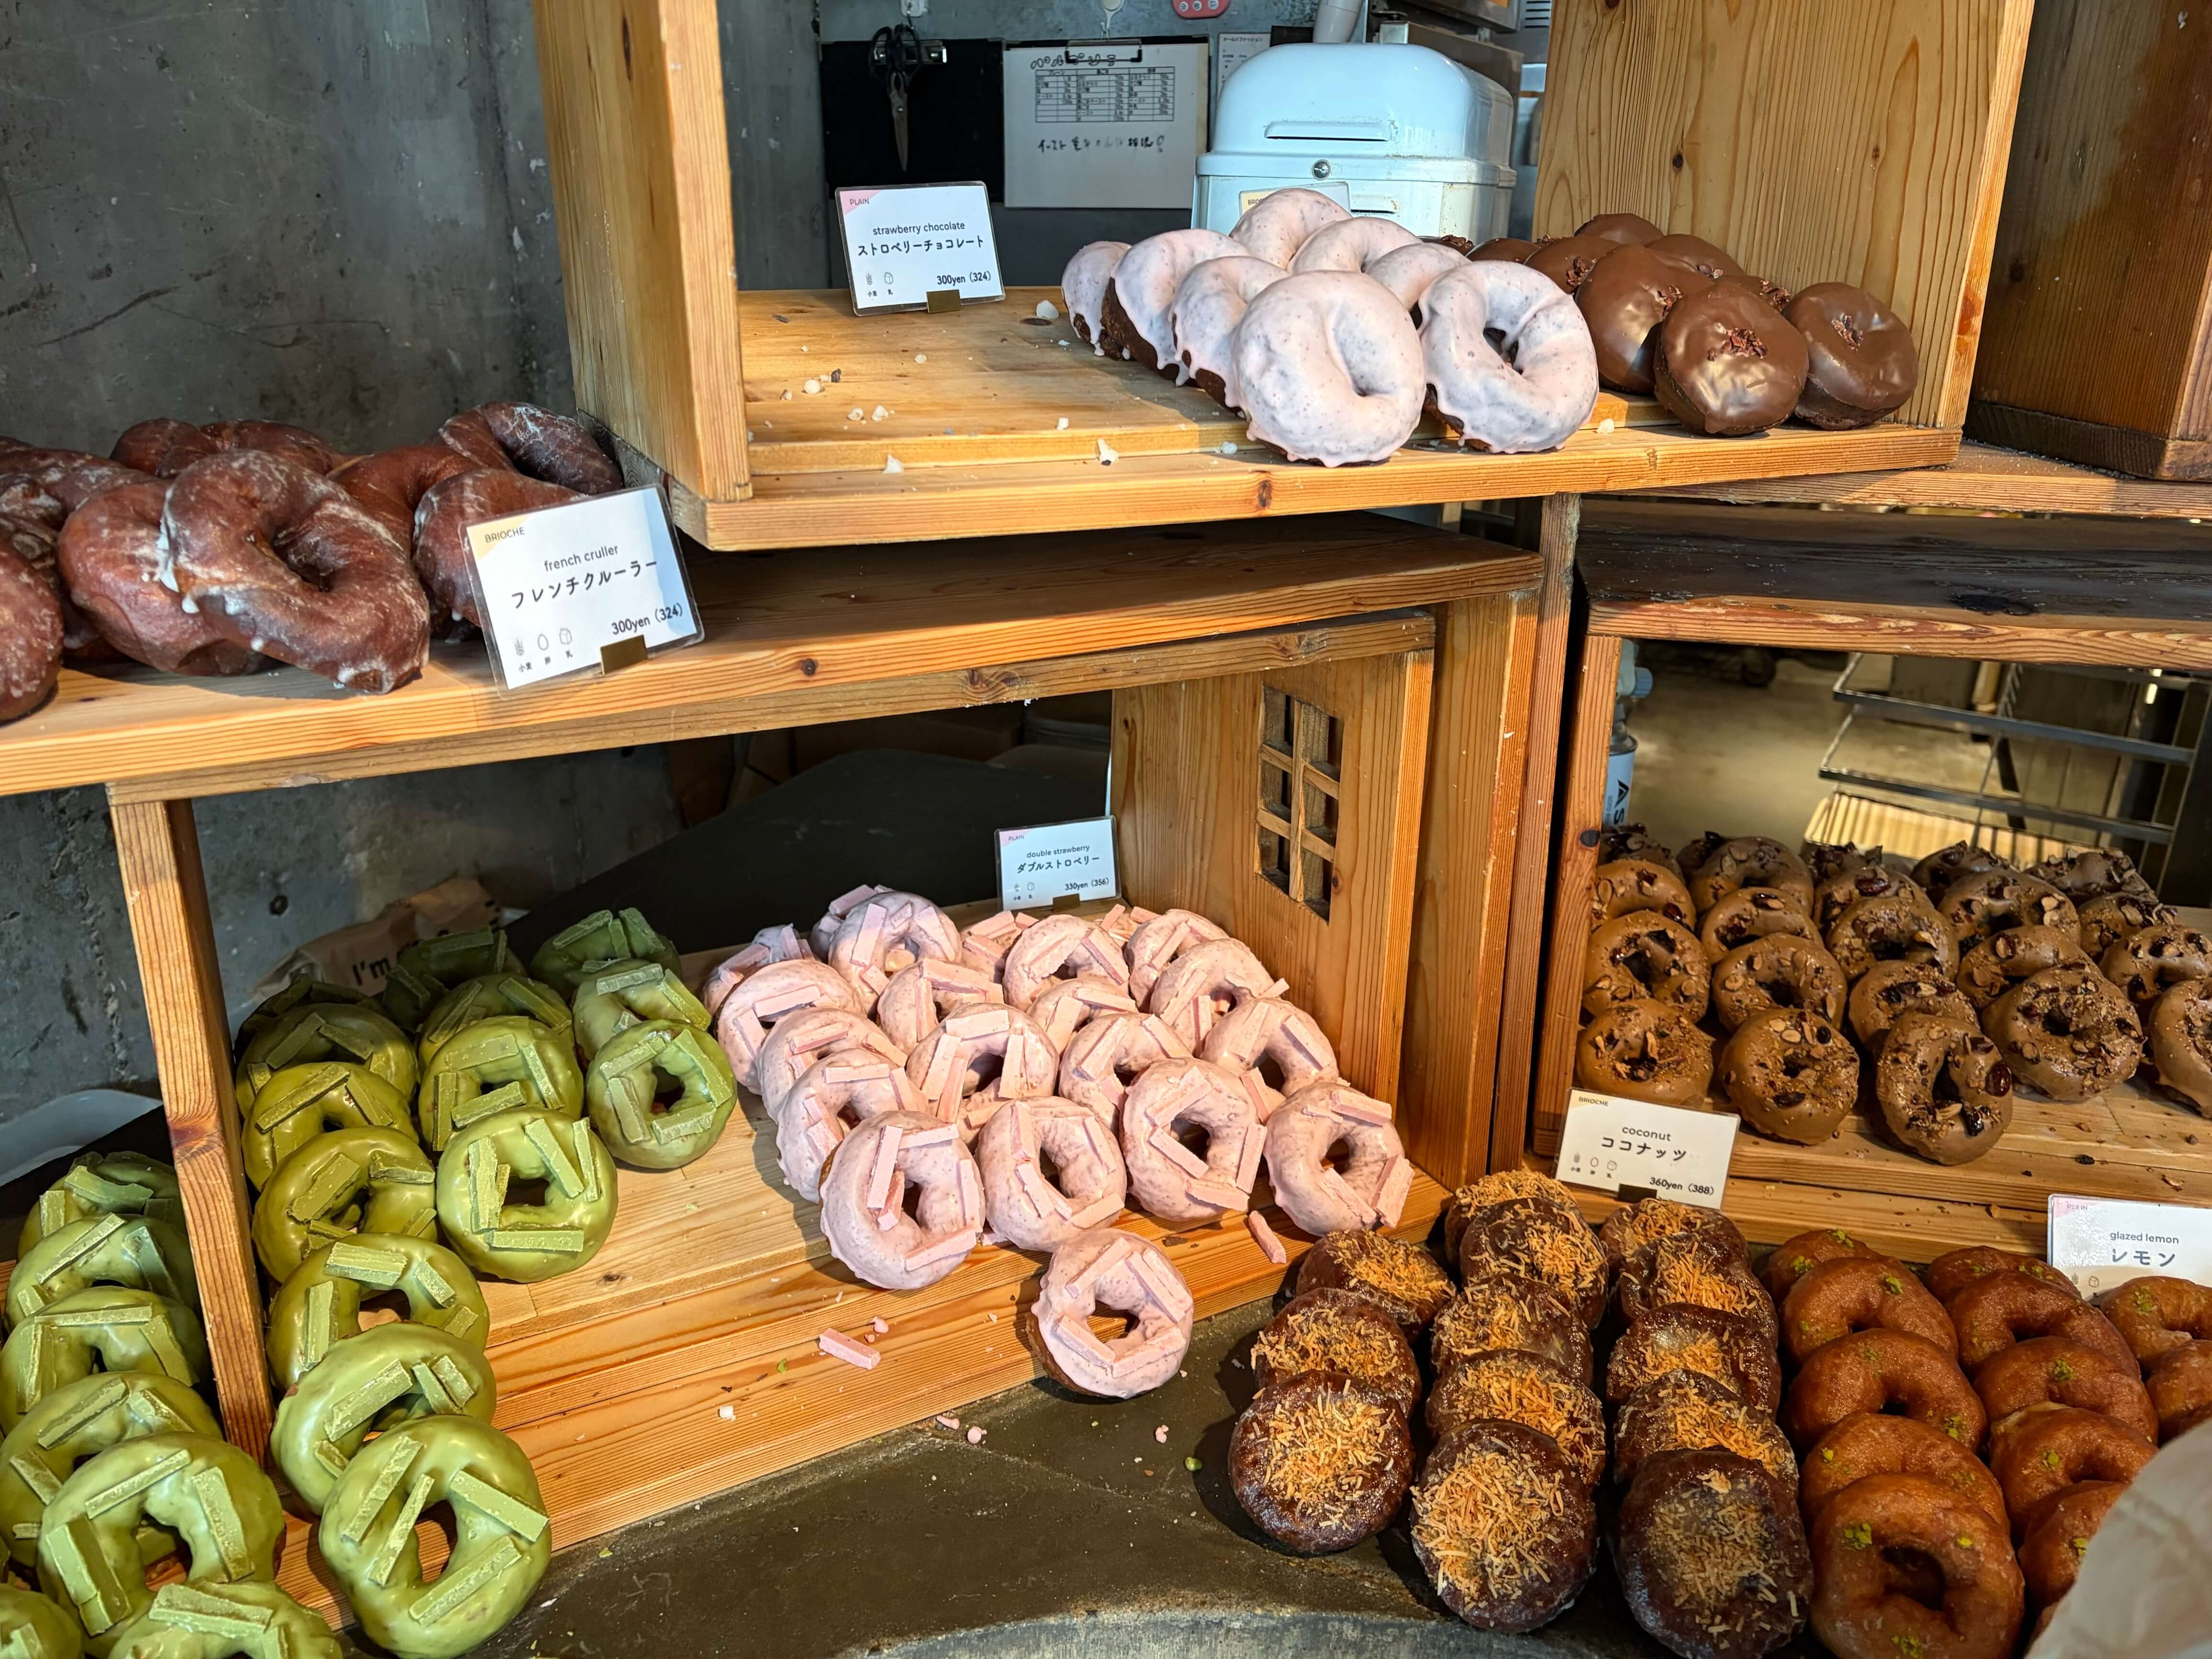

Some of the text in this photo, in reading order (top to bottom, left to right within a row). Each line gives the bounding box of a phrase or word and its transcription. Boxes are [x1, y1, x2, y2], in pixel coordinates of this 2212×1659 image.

[873, 221, 965, 235] strawberry chocolate
[858, 235, 983, 256] ストロベリーチョコレート
[936, 271, 991, 286] 300yen (324)
[485, 527, 525, 543] BRIOCHE
[544, 545, 619, 571] french cruller
[512, 559, 658, 609] フレンチクルーラー
[611, 602, 683, 635] 300yen (324)
[1027, 845, 1090, 858] double strawberry
[1017, 855, 1100, 874] ダブルストロベリー
[1065, 877, 1109, 890] 330yen (356)
[352, 957, 391, 986] I'm
[1578, 1096, 1608, 1107] BRIOCHE
[1622, 1126, 1671, 1142] coconut
[1601, 1136, 1687, 1162] ココナッツ
[1649, 1177, 1715, 1196] 360yen (388)
[2109, 1231, 2179, 1244] glazed lemon
[2111, 1248, 2176, 1267] レモン
